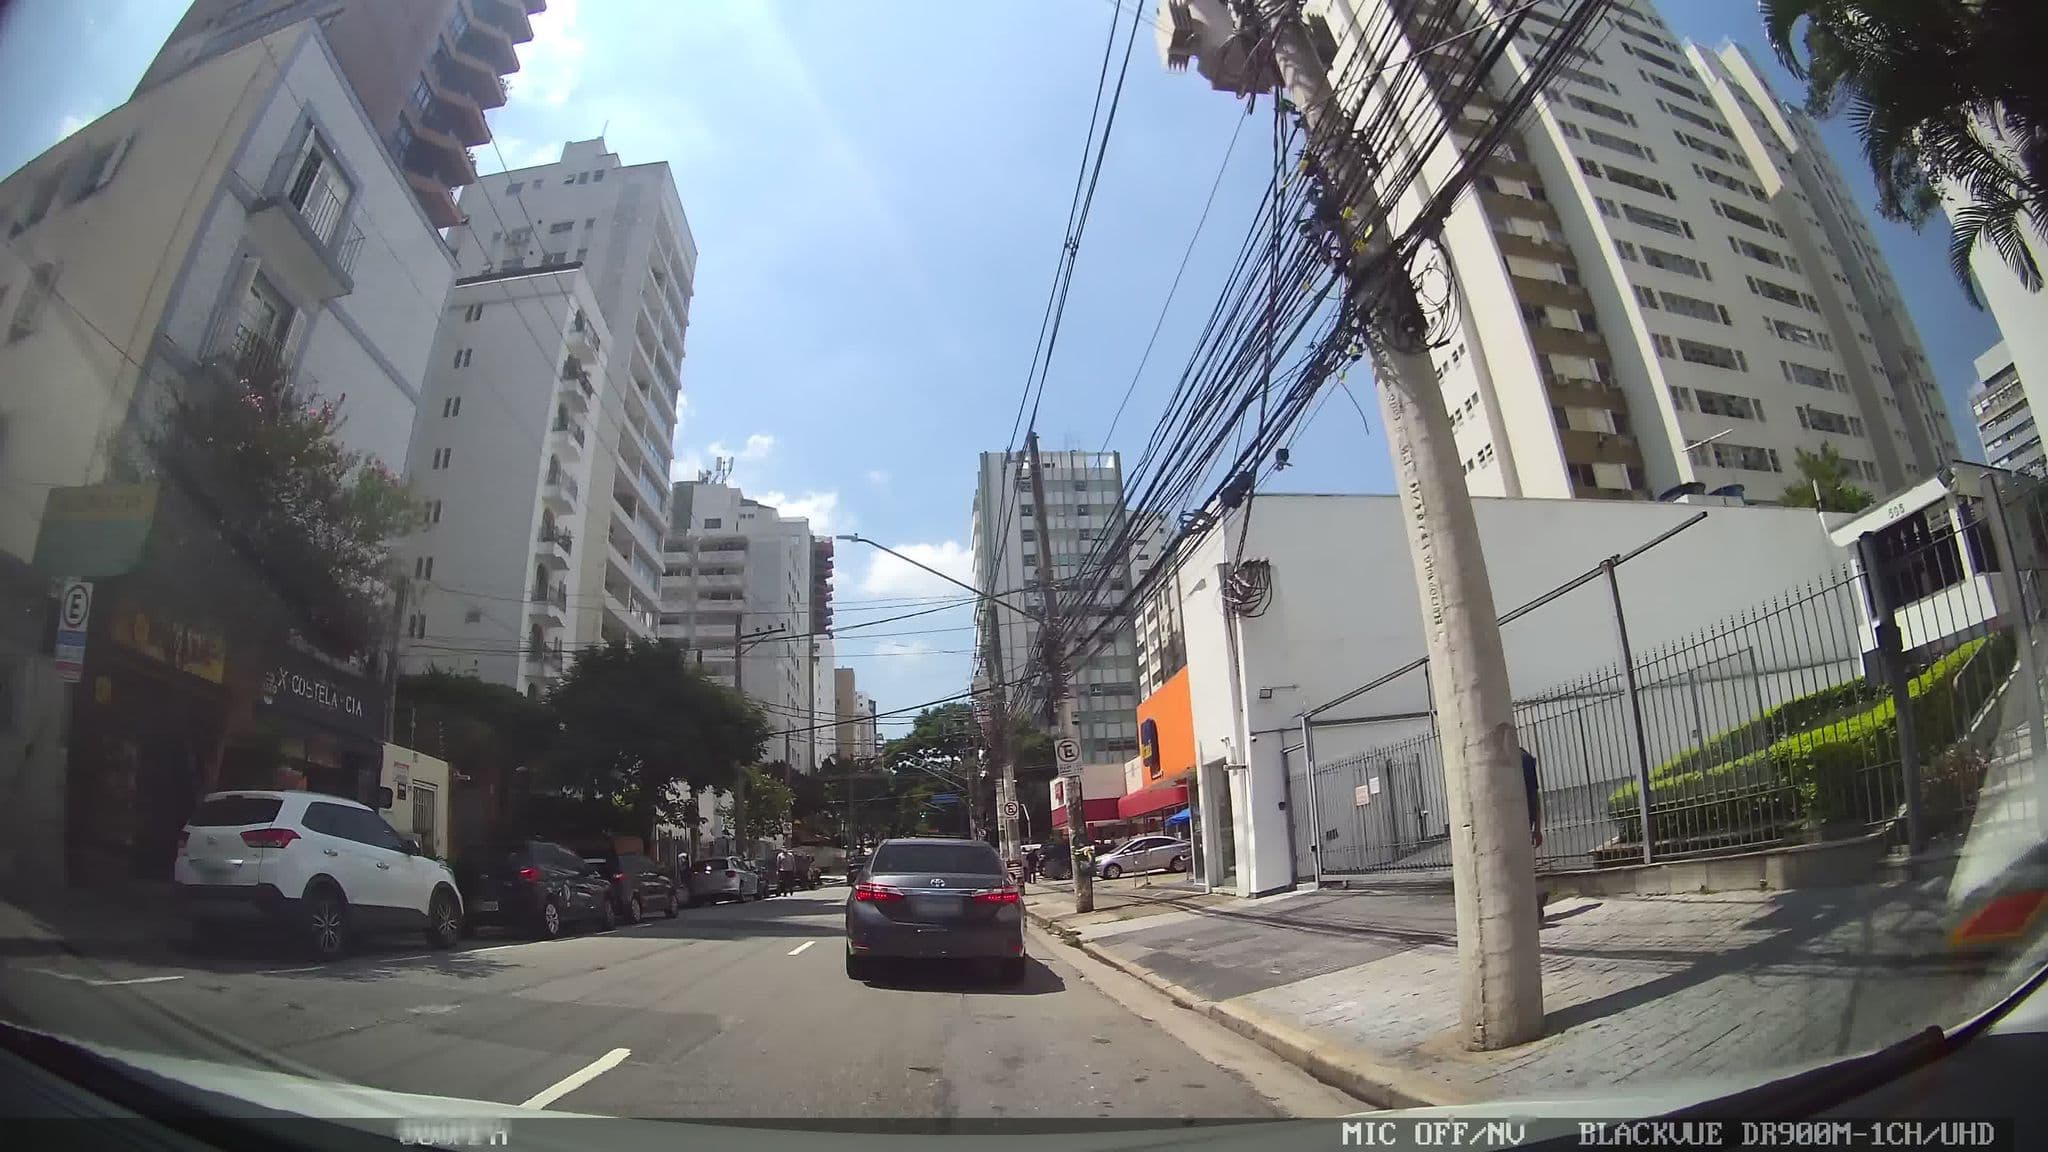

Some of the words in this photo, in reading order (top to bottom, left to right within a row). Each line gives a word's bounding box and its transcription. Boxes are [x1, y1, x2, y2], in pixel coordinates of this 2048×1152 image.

[70, 594, 82, 618] E
[292, 675, 338, 709] COSTELA
[346, 696, 362, 718] CIA
[1064, 744, 1076, 758] E
